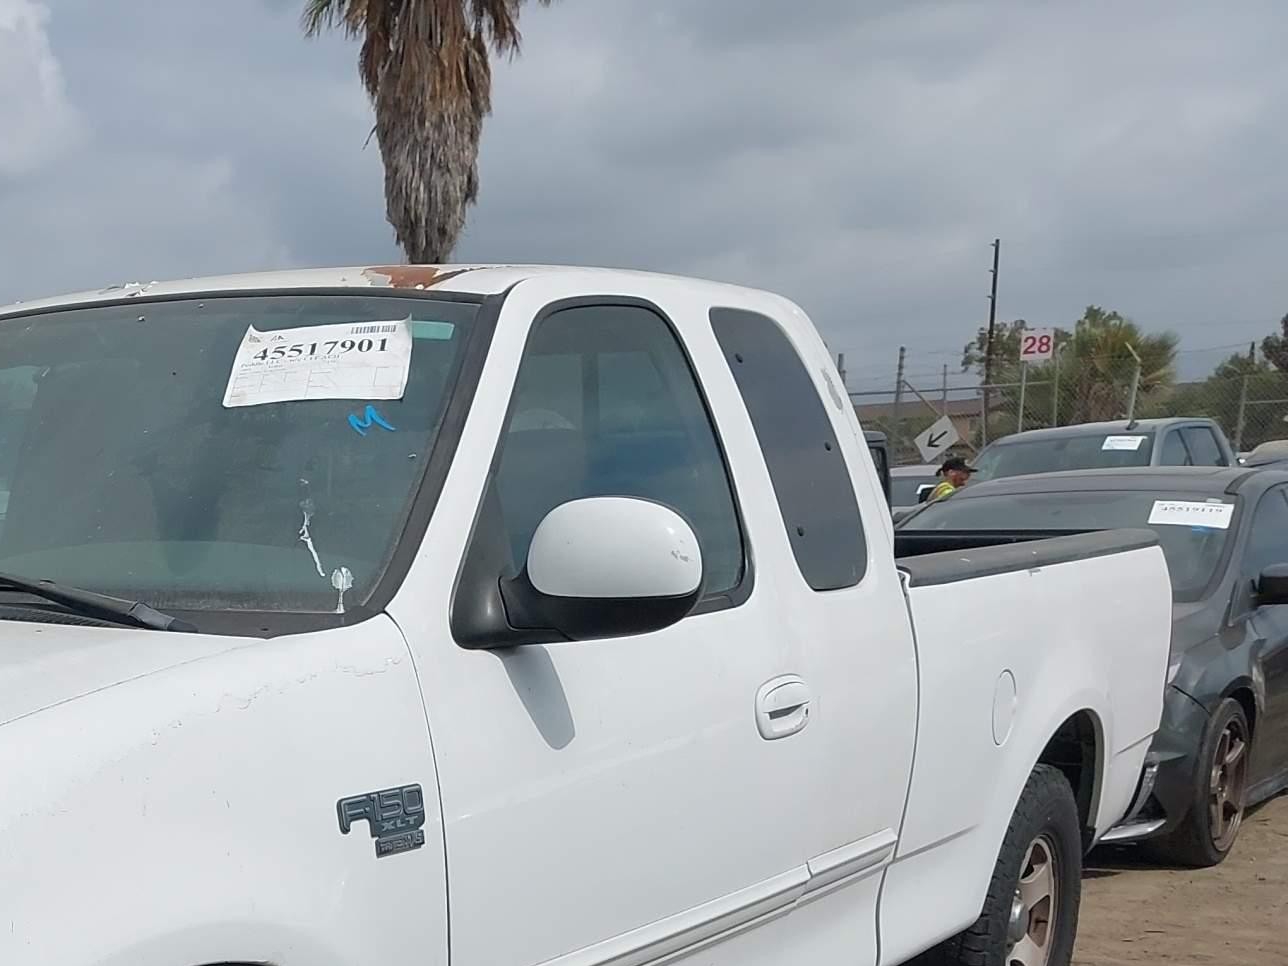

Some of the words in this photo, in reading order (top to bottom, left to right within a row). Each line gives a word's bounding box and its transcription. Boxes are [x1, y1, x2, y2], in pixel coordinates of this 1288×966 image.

[253, 338, 389, 361] 45517901
[1023, 335, 1051, 355] 28
[381, 815, 418, 832] XLT
